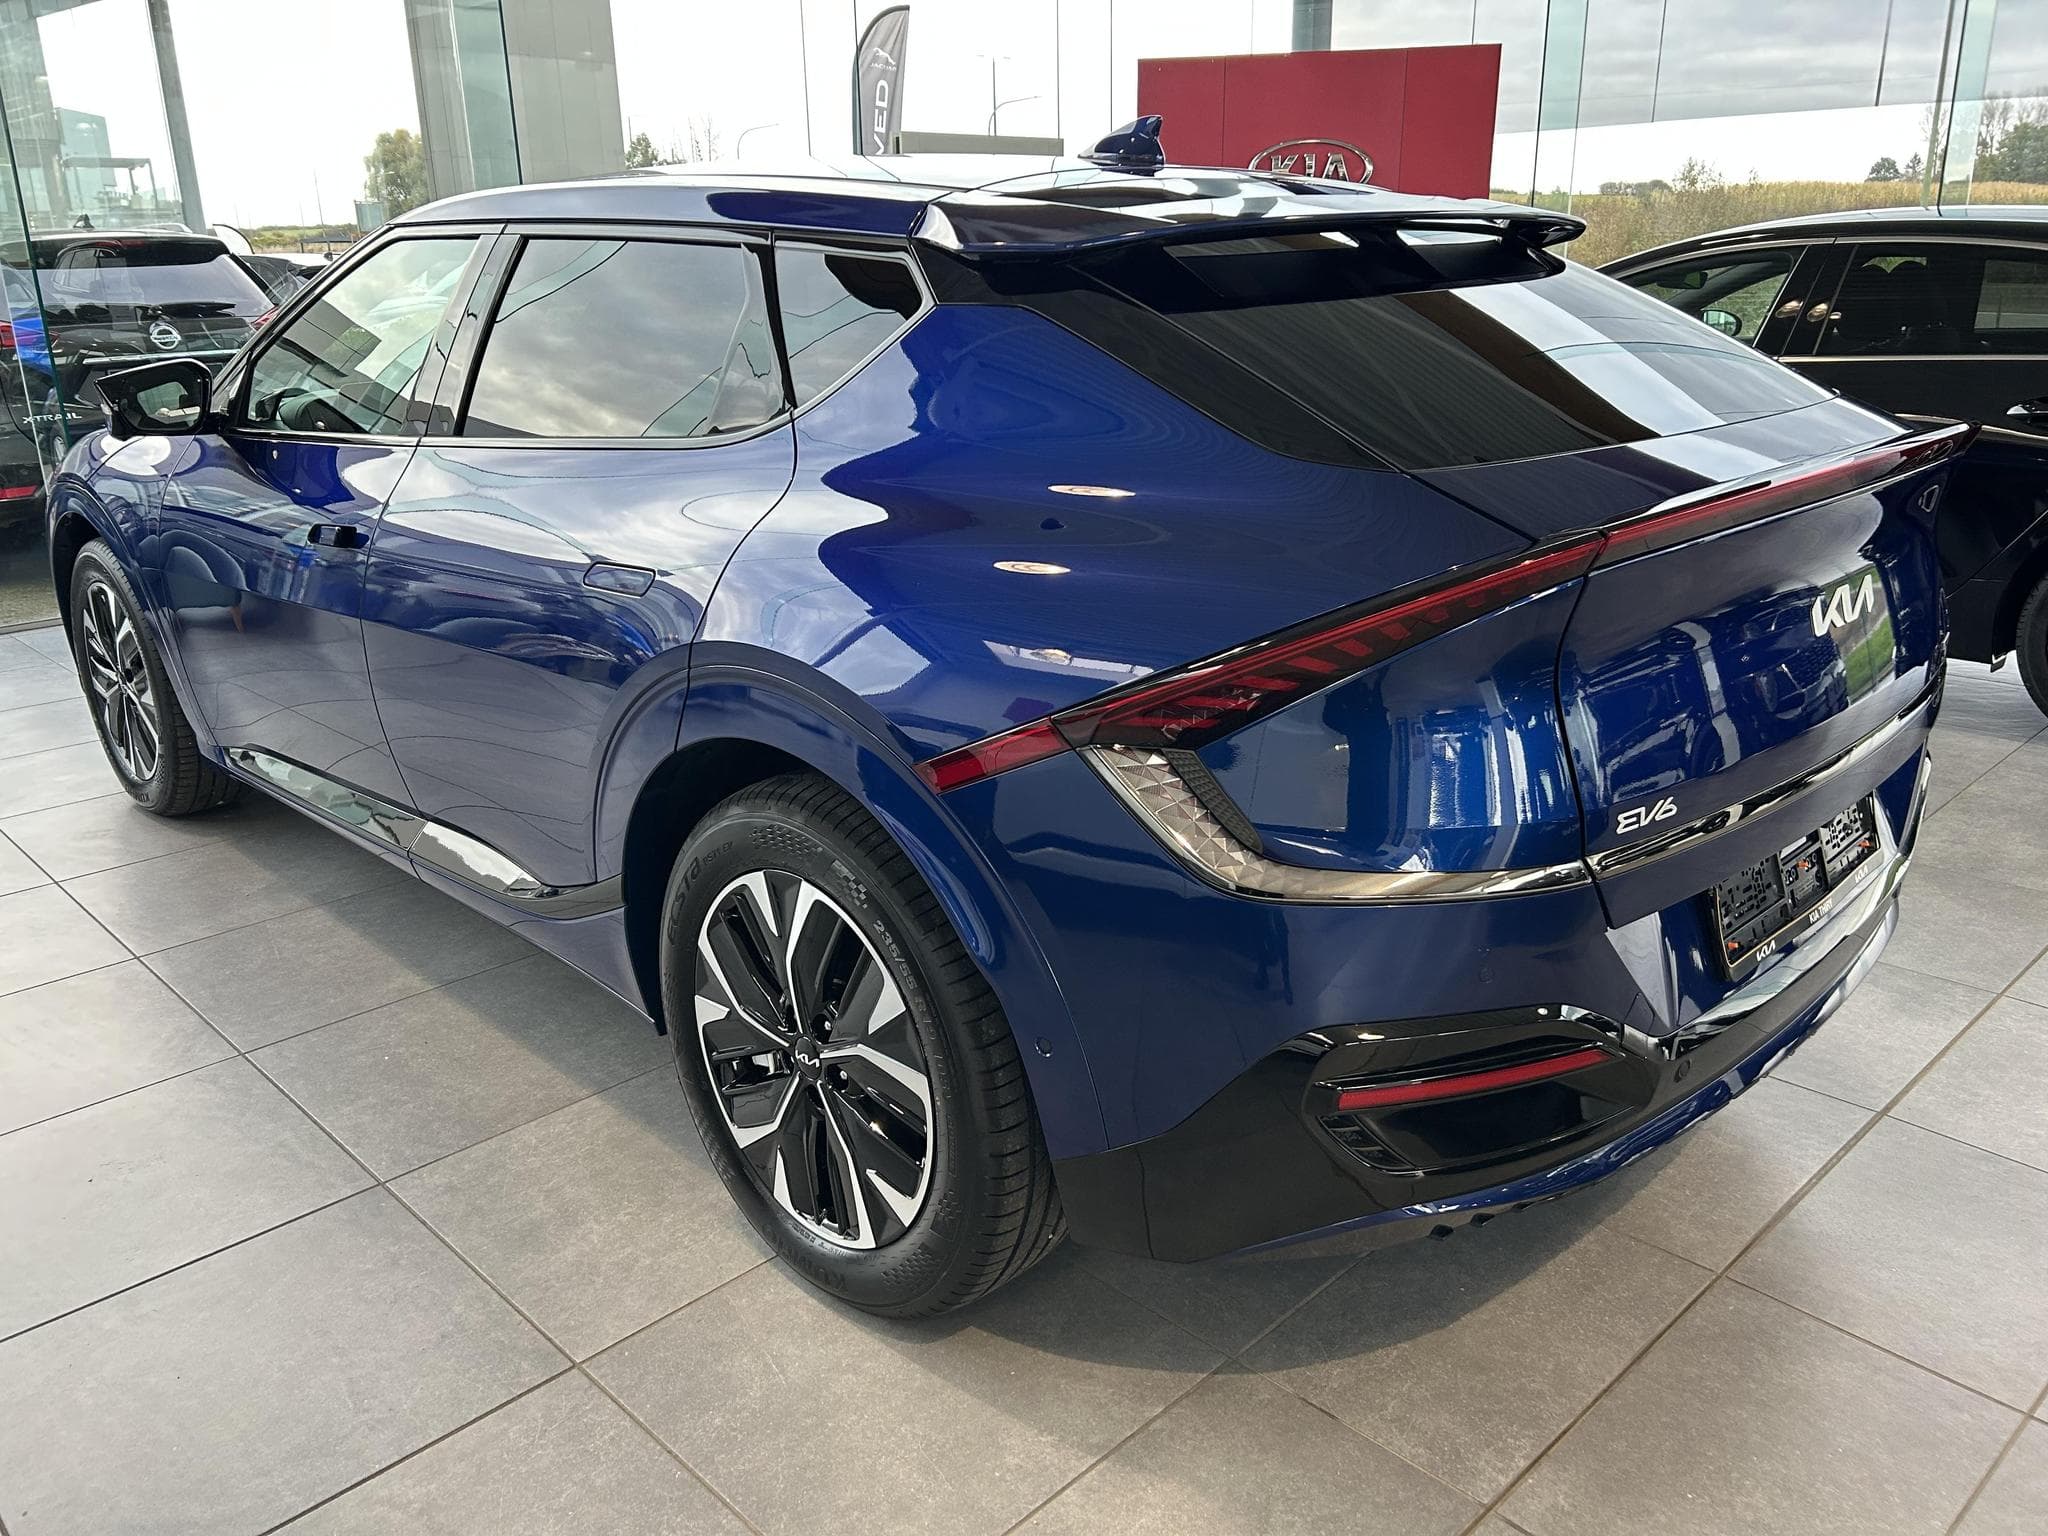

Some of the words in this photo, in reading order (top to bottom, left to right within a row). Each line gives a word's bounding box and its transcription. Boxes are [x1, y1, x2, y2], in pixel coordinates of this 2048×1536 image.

[1270, 152, 1349, 182] KIA
[1616, 796, 1678, 835] EV6
[1809, 911, 1821, 924] KIA
[873, 919, 919, 990] 235/55
